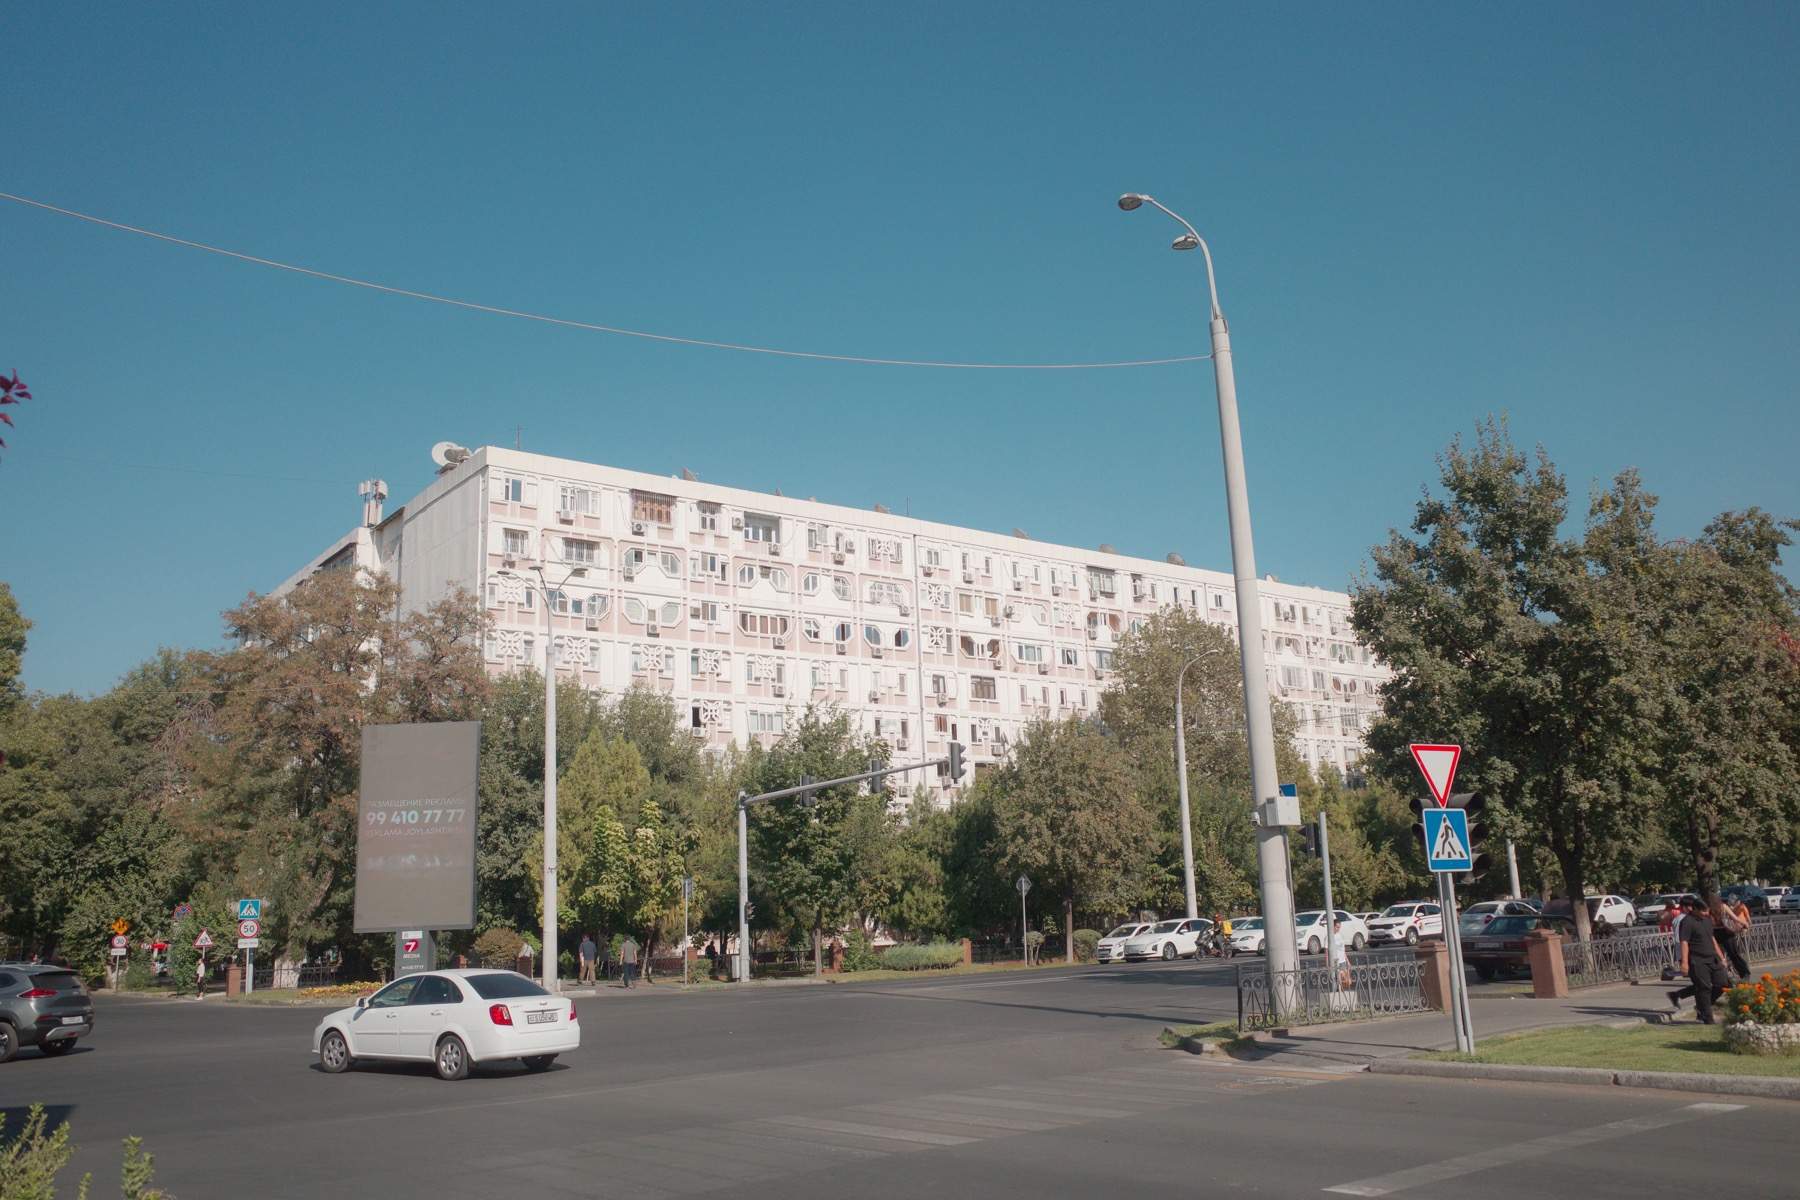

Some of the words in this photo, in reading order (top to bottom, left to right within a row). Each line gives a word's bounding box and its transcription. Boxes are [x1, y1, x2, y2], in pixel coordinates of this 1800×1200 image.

[425, 798, 465, 806] РЕКЛАМ
[366, 811, 386, 825] 99
[391, 810, 419, 825] 410
[422, 810, 443, 824] 77
[446, 809, 466, 823] 77
[243, 924, 255, 933] 50
[404, 941, 416, 953] 7
